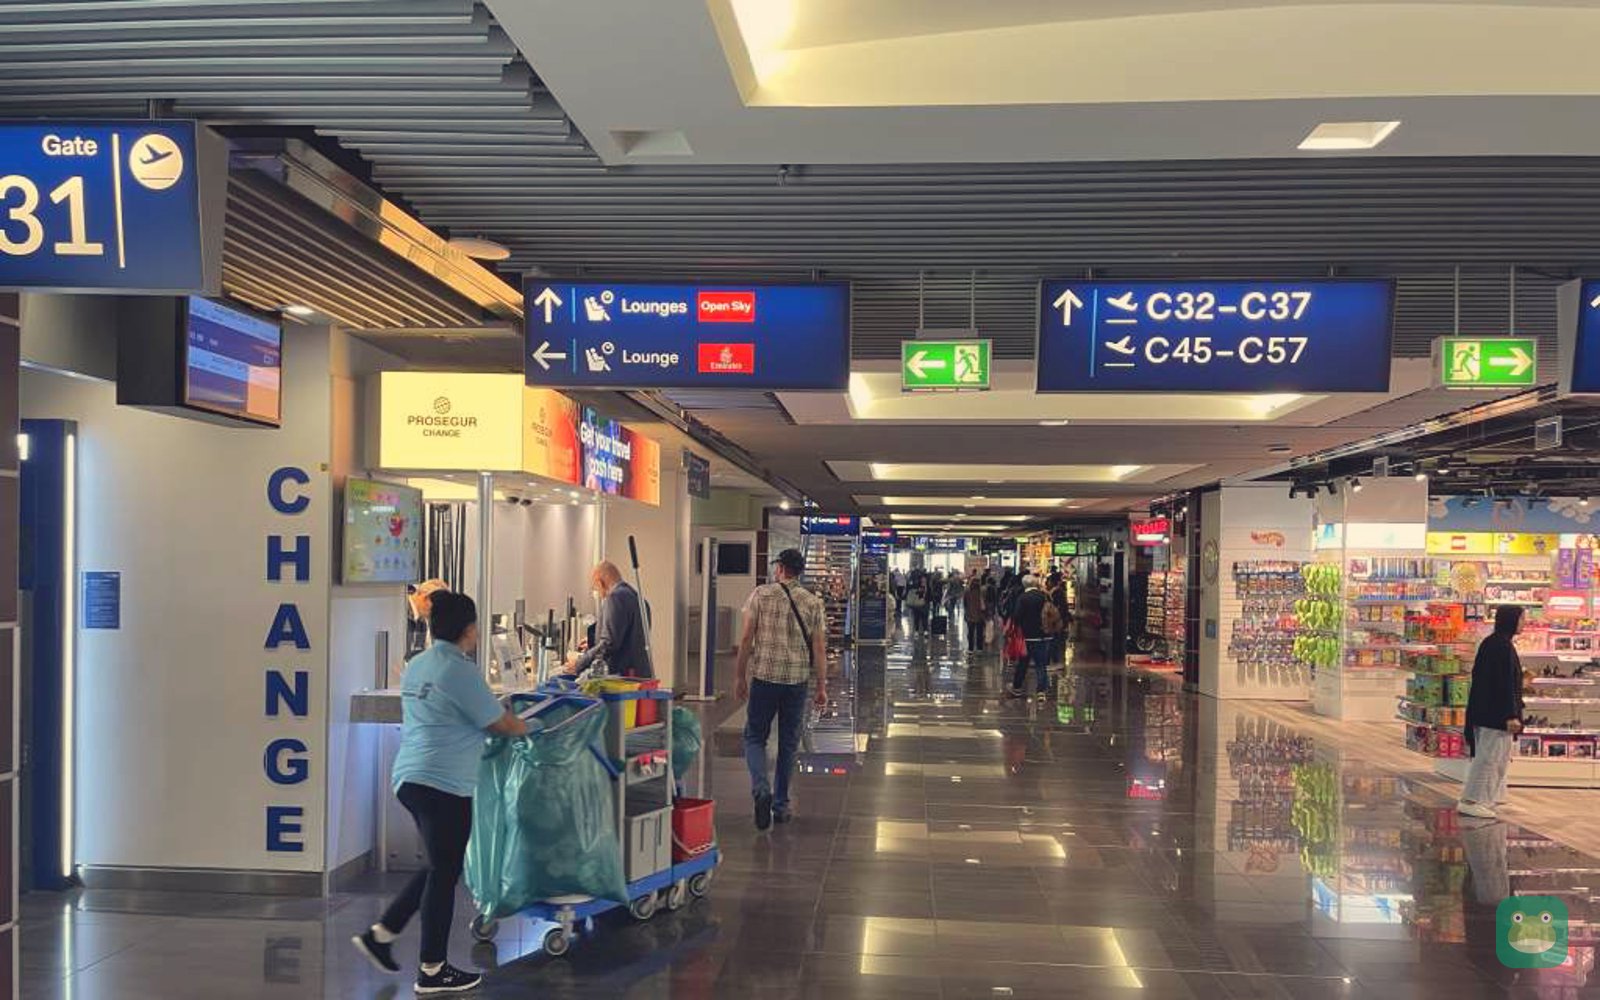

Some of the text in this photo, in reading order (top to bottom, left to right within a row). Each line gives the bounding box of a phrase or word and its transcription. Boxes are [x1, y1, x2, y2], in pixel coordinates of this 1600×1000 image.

[42, 134, 98, 157] Gate
[0, 174, 104, 255] 31
[622, 298, 688, 316] Lounges
[700, 300, 752, 314] Open Sky
[1146, 292, 1312, 320] C32-C37
[622, 350, 679, 368] Lounge
[1144, 337, 1309, 364] C45-C57
[407, 414, 477, 428] PROSEGUR
[422, 428, 461, 438] CHANGE
[580, 421, 595, 446] Get
[264, 466, 311, 852] CHANGE
